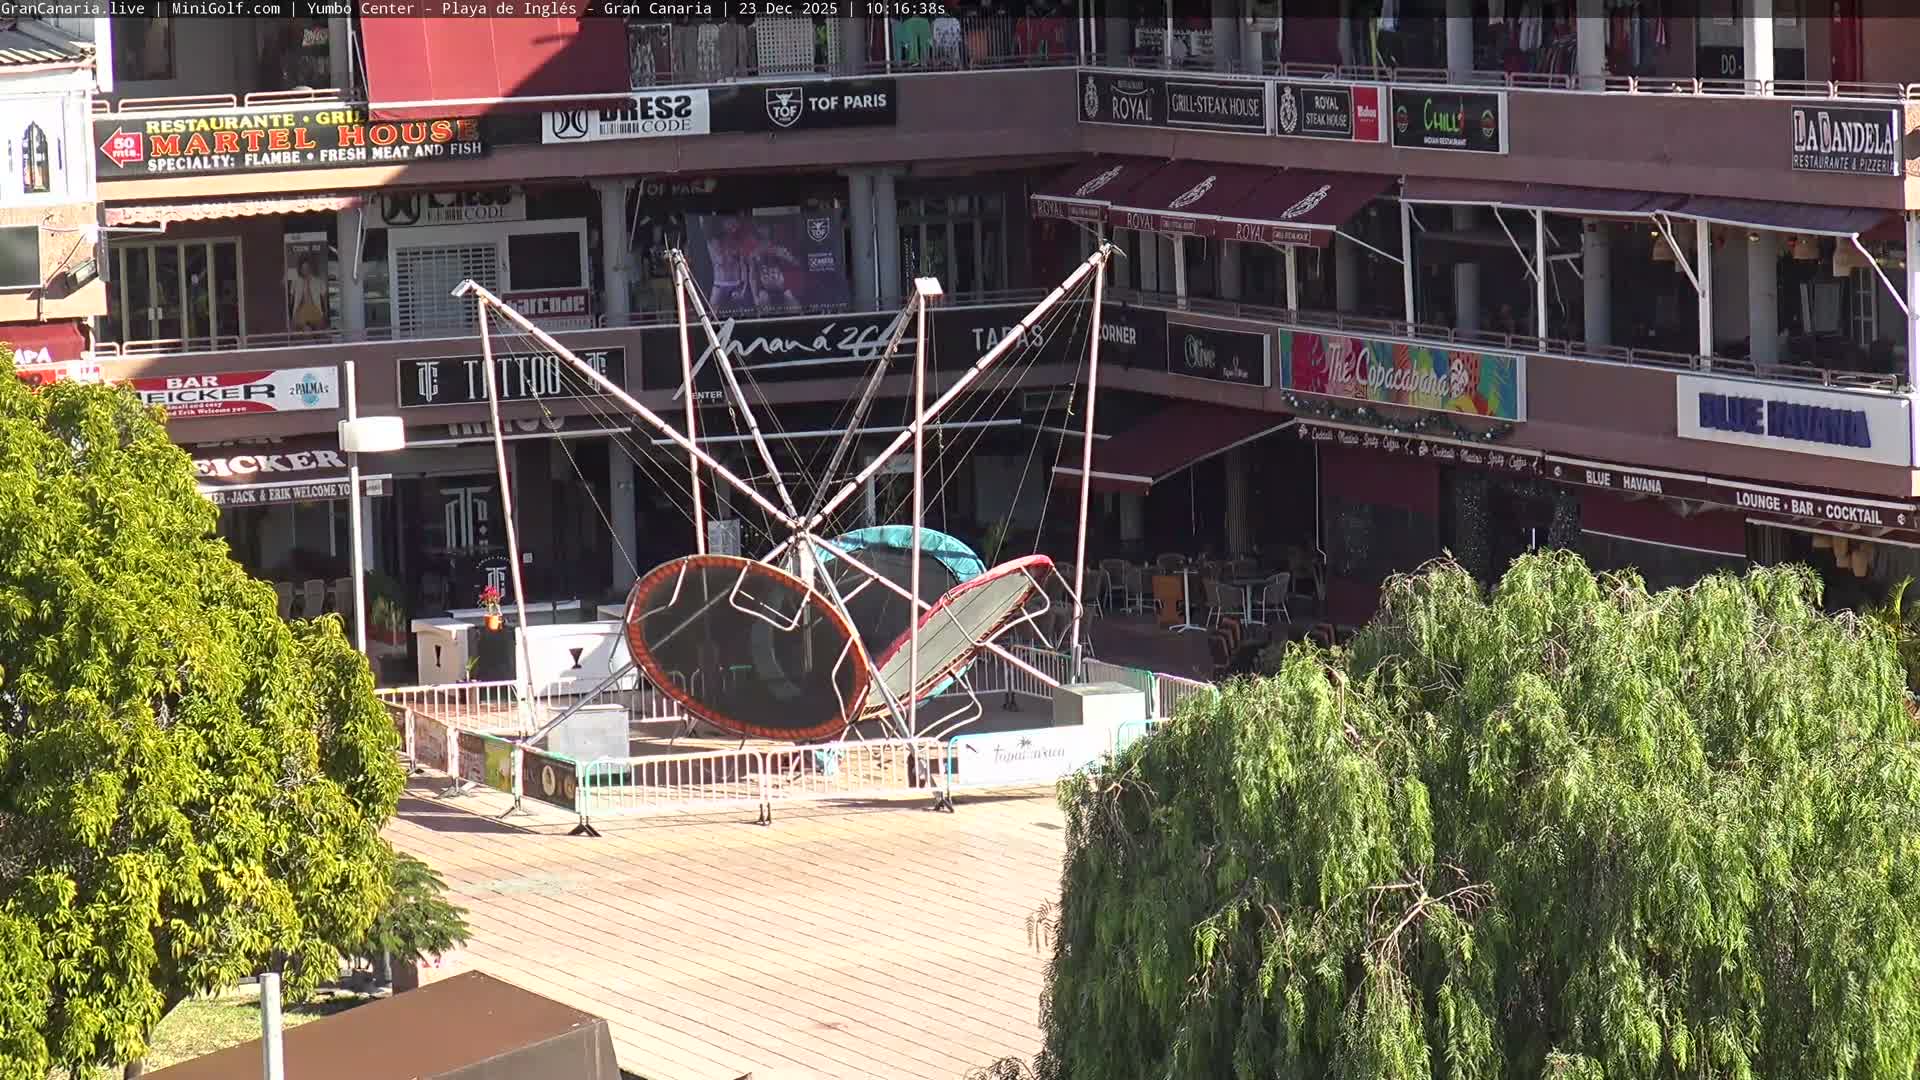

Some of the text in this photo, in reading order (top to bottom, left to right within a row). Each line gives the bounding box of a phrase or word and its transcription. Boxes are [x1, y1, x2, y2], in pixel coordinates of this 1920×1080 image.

[773, 105, 797, 118] TOF
[809, 93, 887, 111] TOF PARIS
[1112, 96, 1153, 120] ROYAL
[1230, 98, 1260, 117] HOUSE
[1315, 95, 1339, 110] ROYAL
[146, 113, 295, 134] RESTAURANTE
[641, 119, 692, 133] CODE
[1306, 111, 1347, 128] STEAK HOUSE
[114, 137, 134, 148] 50
[151, 119, 480, 157] MARTEL HOUSE
[148, 142, 482, 172] SPECIALTY: FLAMBE FRESH MEAT AND FISH
[1794, 154, 1895, 173] RESTAURANTE & PIZZERIA
[1038, 200, 1064, 217] ROYAL
[1128, 212, 1154, 230] ROYAL
[1236, 223, 1265, 241] ROYAL
[1098, 323, 1137, 345] ORNER
[1326, 342, 1452, 397] The Copacabana
[166, 375, 219, 390] BAR
[1699, 391, 1872, 449] BLUE HAVANA
[196, 450, 346, 477] EICKER
[1586, 470, 1663, 494] BLUE HAVANA
[231, 490, 256, 504] JACK
[260, 490, 266, 501] &
[269, 487, 291, 500] ERIK
[293, 484, 337, 498] WELCOME
[338, 482, 351, 495] YO
[1736, 491, 1883, 525] LOUNGE BAR COCKTAIL
